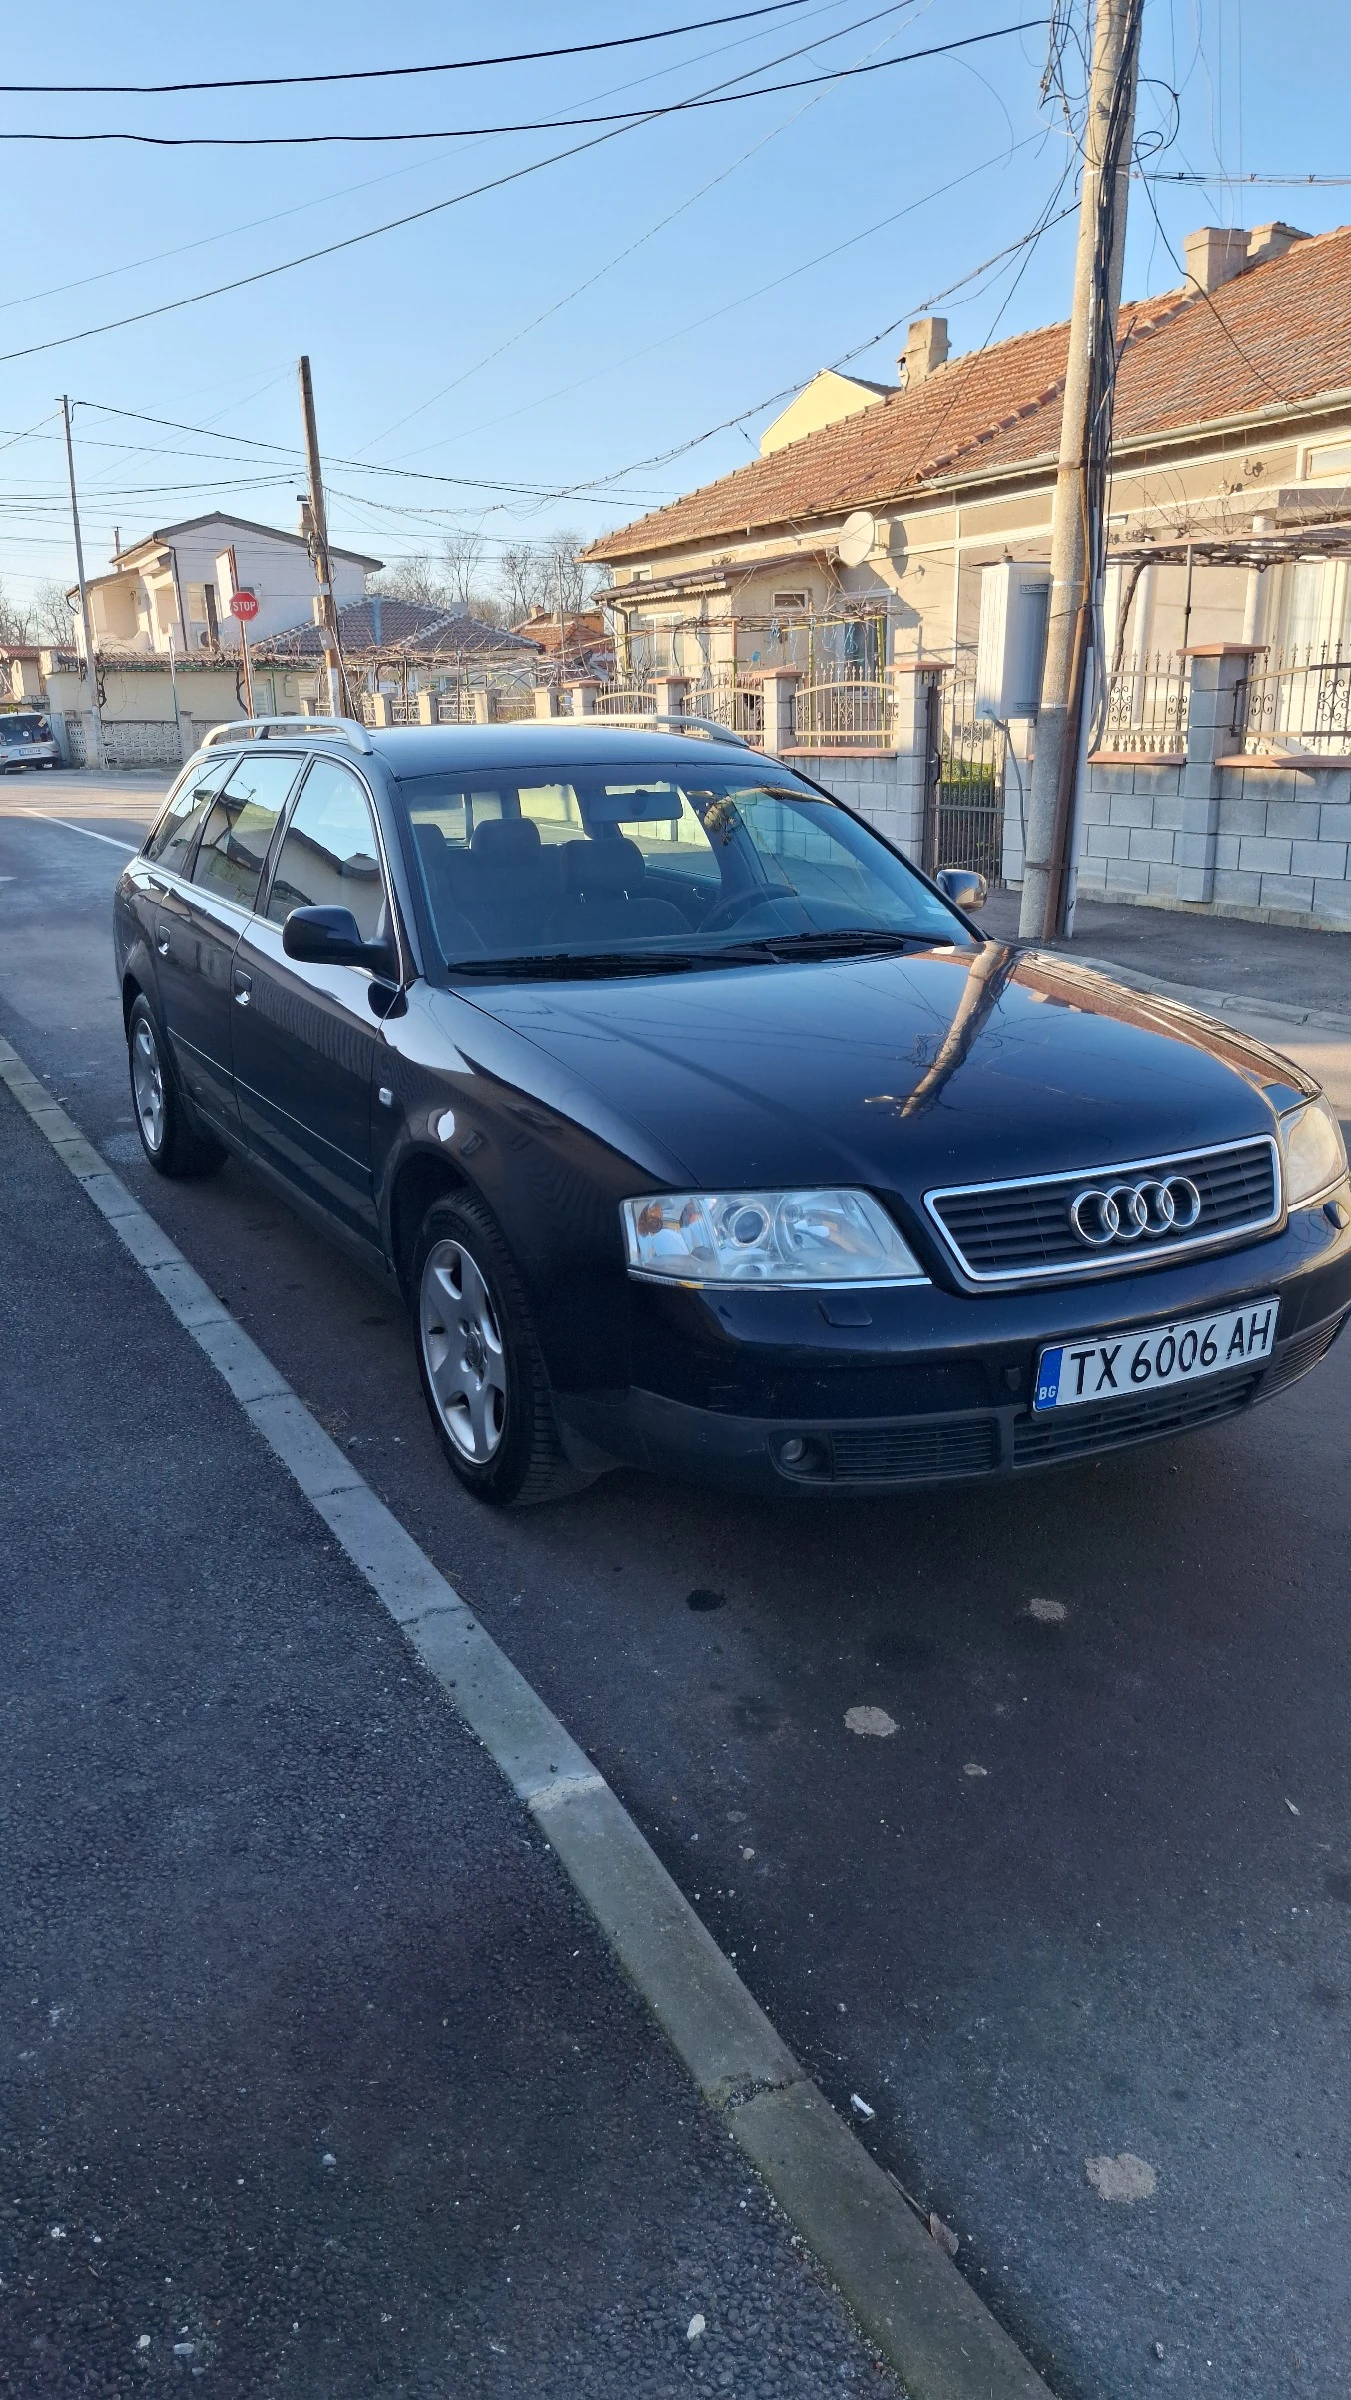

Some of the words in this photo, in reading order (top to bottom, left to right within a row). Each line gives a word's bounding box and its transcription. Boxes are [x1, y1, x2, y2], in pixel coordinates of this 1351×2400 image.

[232, 601, 256, 612] STOP
[1070, 1344, 1122, 1395] TX
[1130, 1323, 1217, 1383] 6006
[1226, 1308, 1272, 1360] AH
[1039, 1385, 1056, 1401] BG
